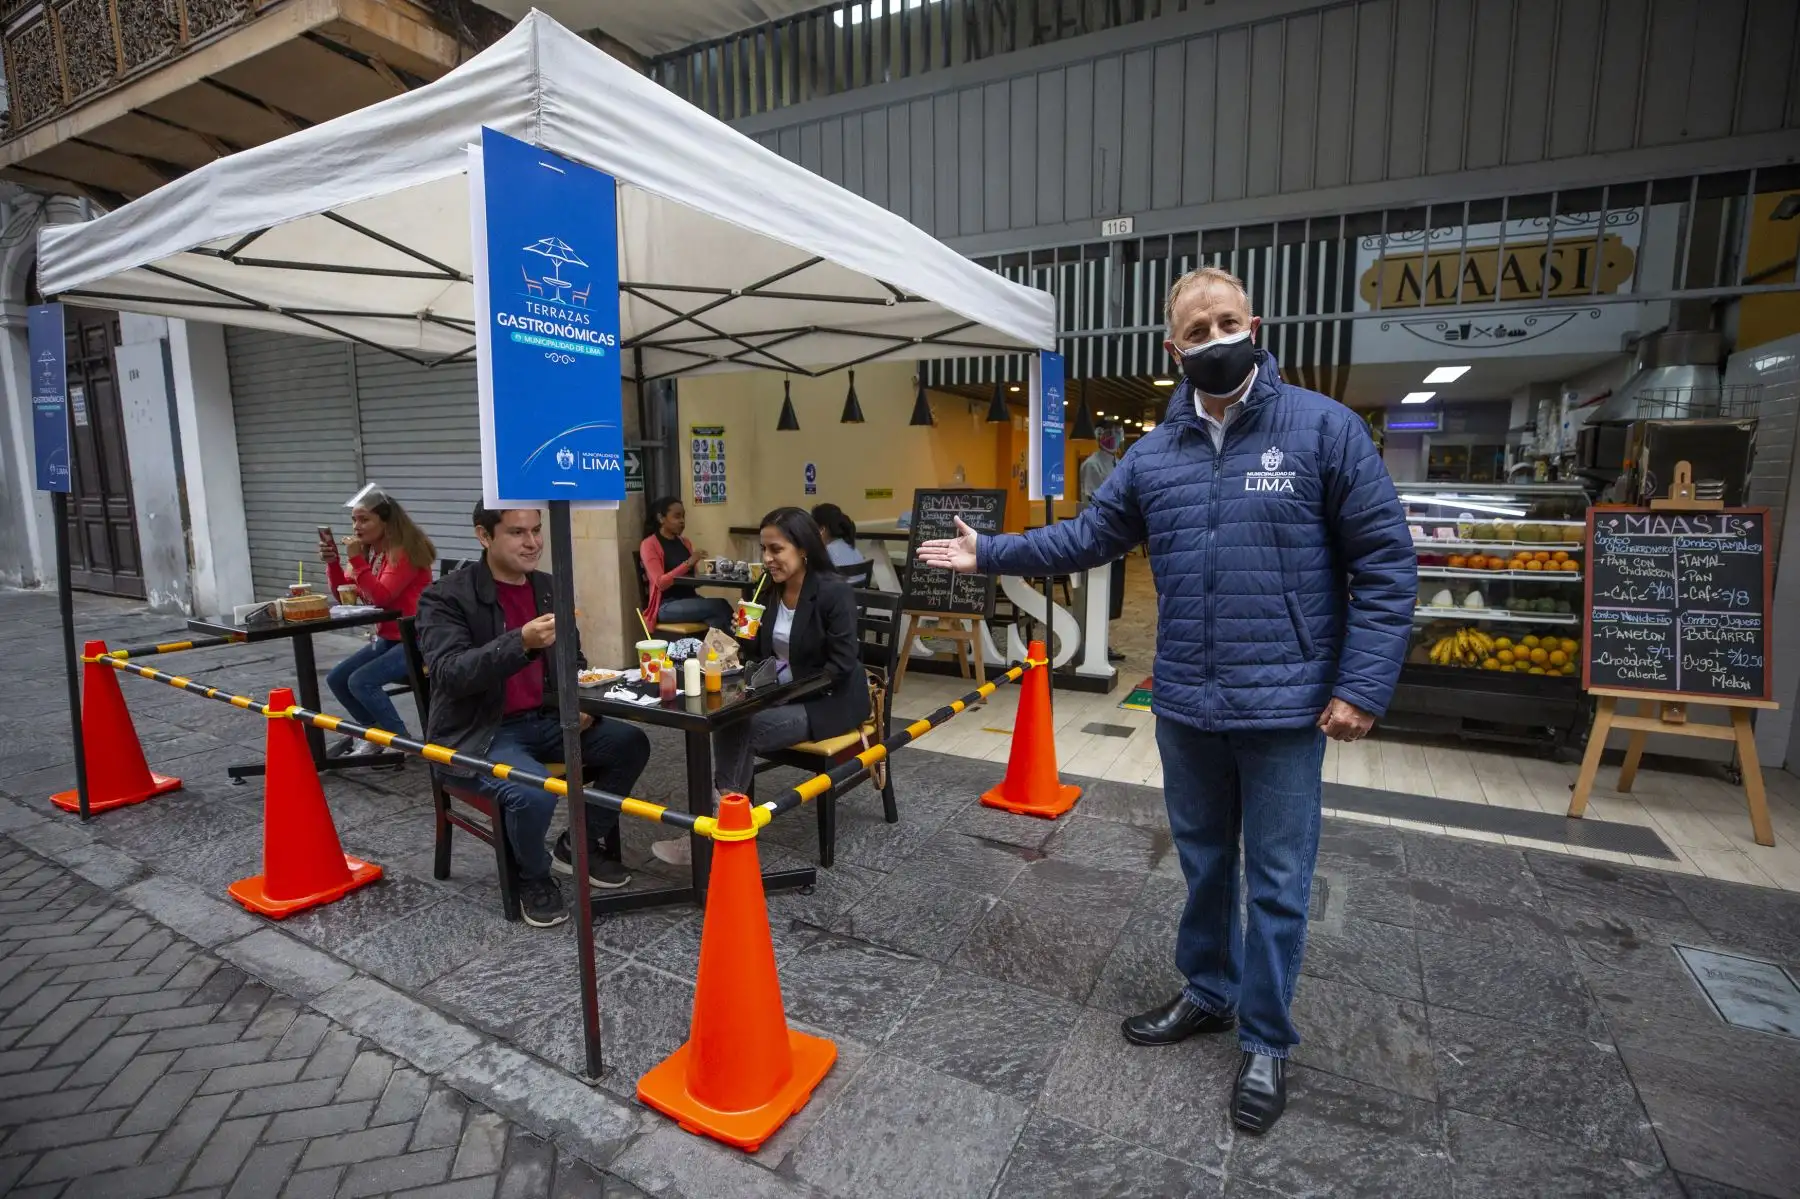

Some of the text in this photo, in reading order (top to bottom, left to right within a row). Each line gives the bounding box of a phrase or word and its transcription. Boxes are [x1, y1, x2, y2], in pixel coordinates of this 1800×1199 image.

[1108, 221, 1127, 234] 116
[1395, 247, 1593, 302] MAASI
[526, 301, 590, 325] TERRAZAS
[497, 312, 615, 346] GASTRONÓMICAS
[524, 335, 575, 351] MUNICIPALIDAD
[585, 346, 602, 355] LIMA
[582, 458, 621, 471] LIMA
[1245, 478, 1294, 492] LIMA
[931, 494, 985, 509] MAASI
[1625, 514, 1732, 535] MAASI
[1676, 536, 1717, 548] Combo
[1685, 570, 1712, 582] PAN
[1592, 609, 1619, 620] Combo
[1681, 612, 1718, 625] Combo
[1709, 662, 1727, 673] de
